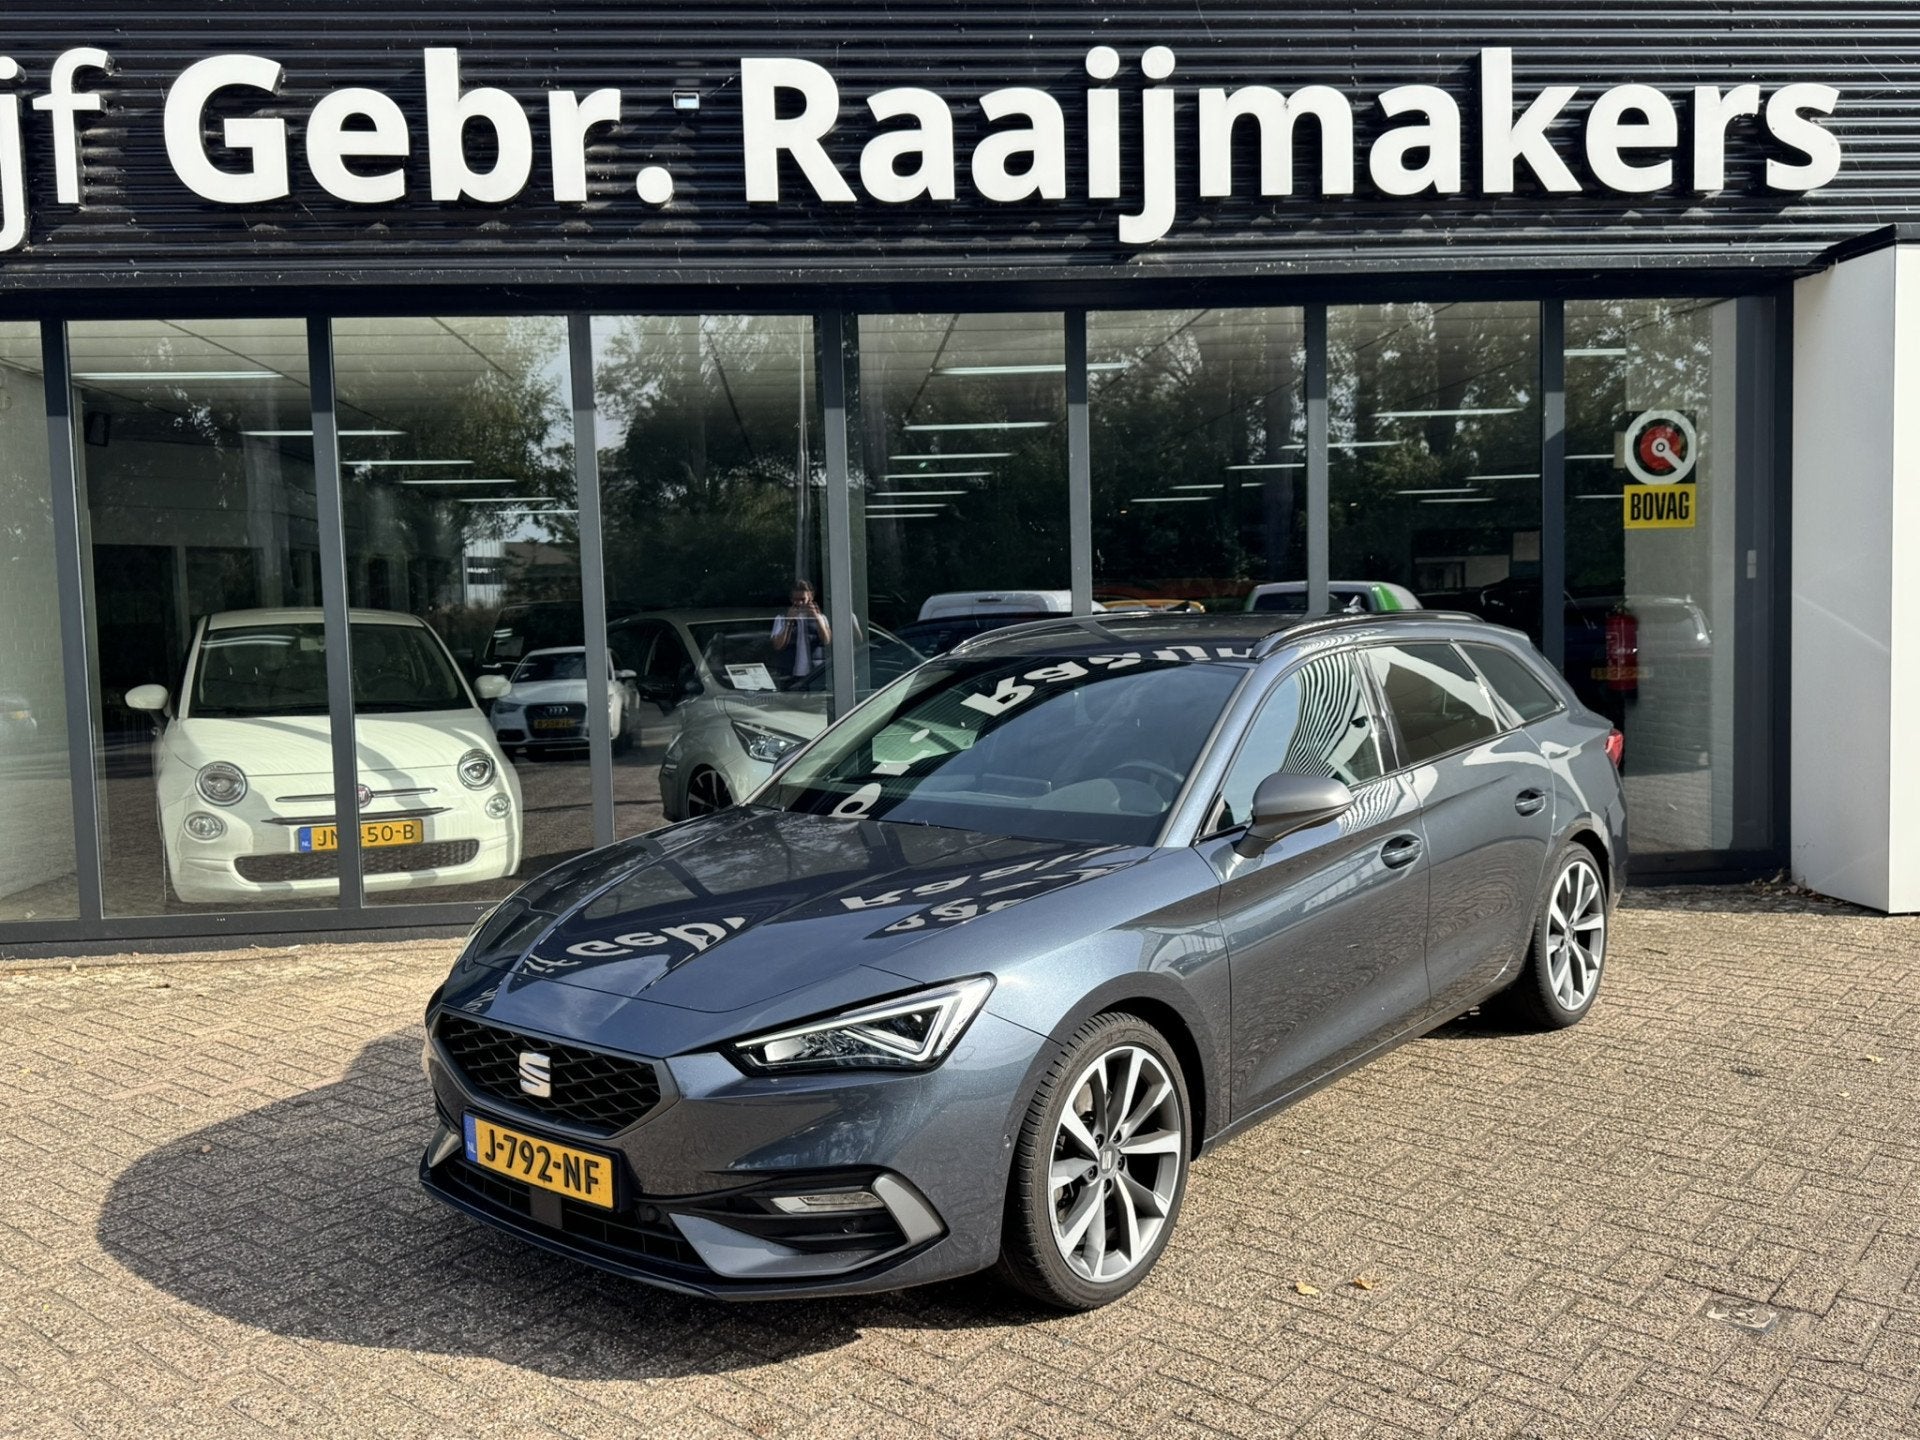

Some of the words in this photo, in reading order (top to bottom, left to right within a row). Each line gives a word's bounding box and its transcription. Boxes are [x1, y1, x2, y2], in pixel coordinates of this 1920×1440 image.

[163, 47, 674, 203] Gebr.
[740, 46, 1842, 244] Raaijmakers
[1631, 491, 1690, 521] BOVAG
[485, 1128, 600, 1195] J-792-NF
